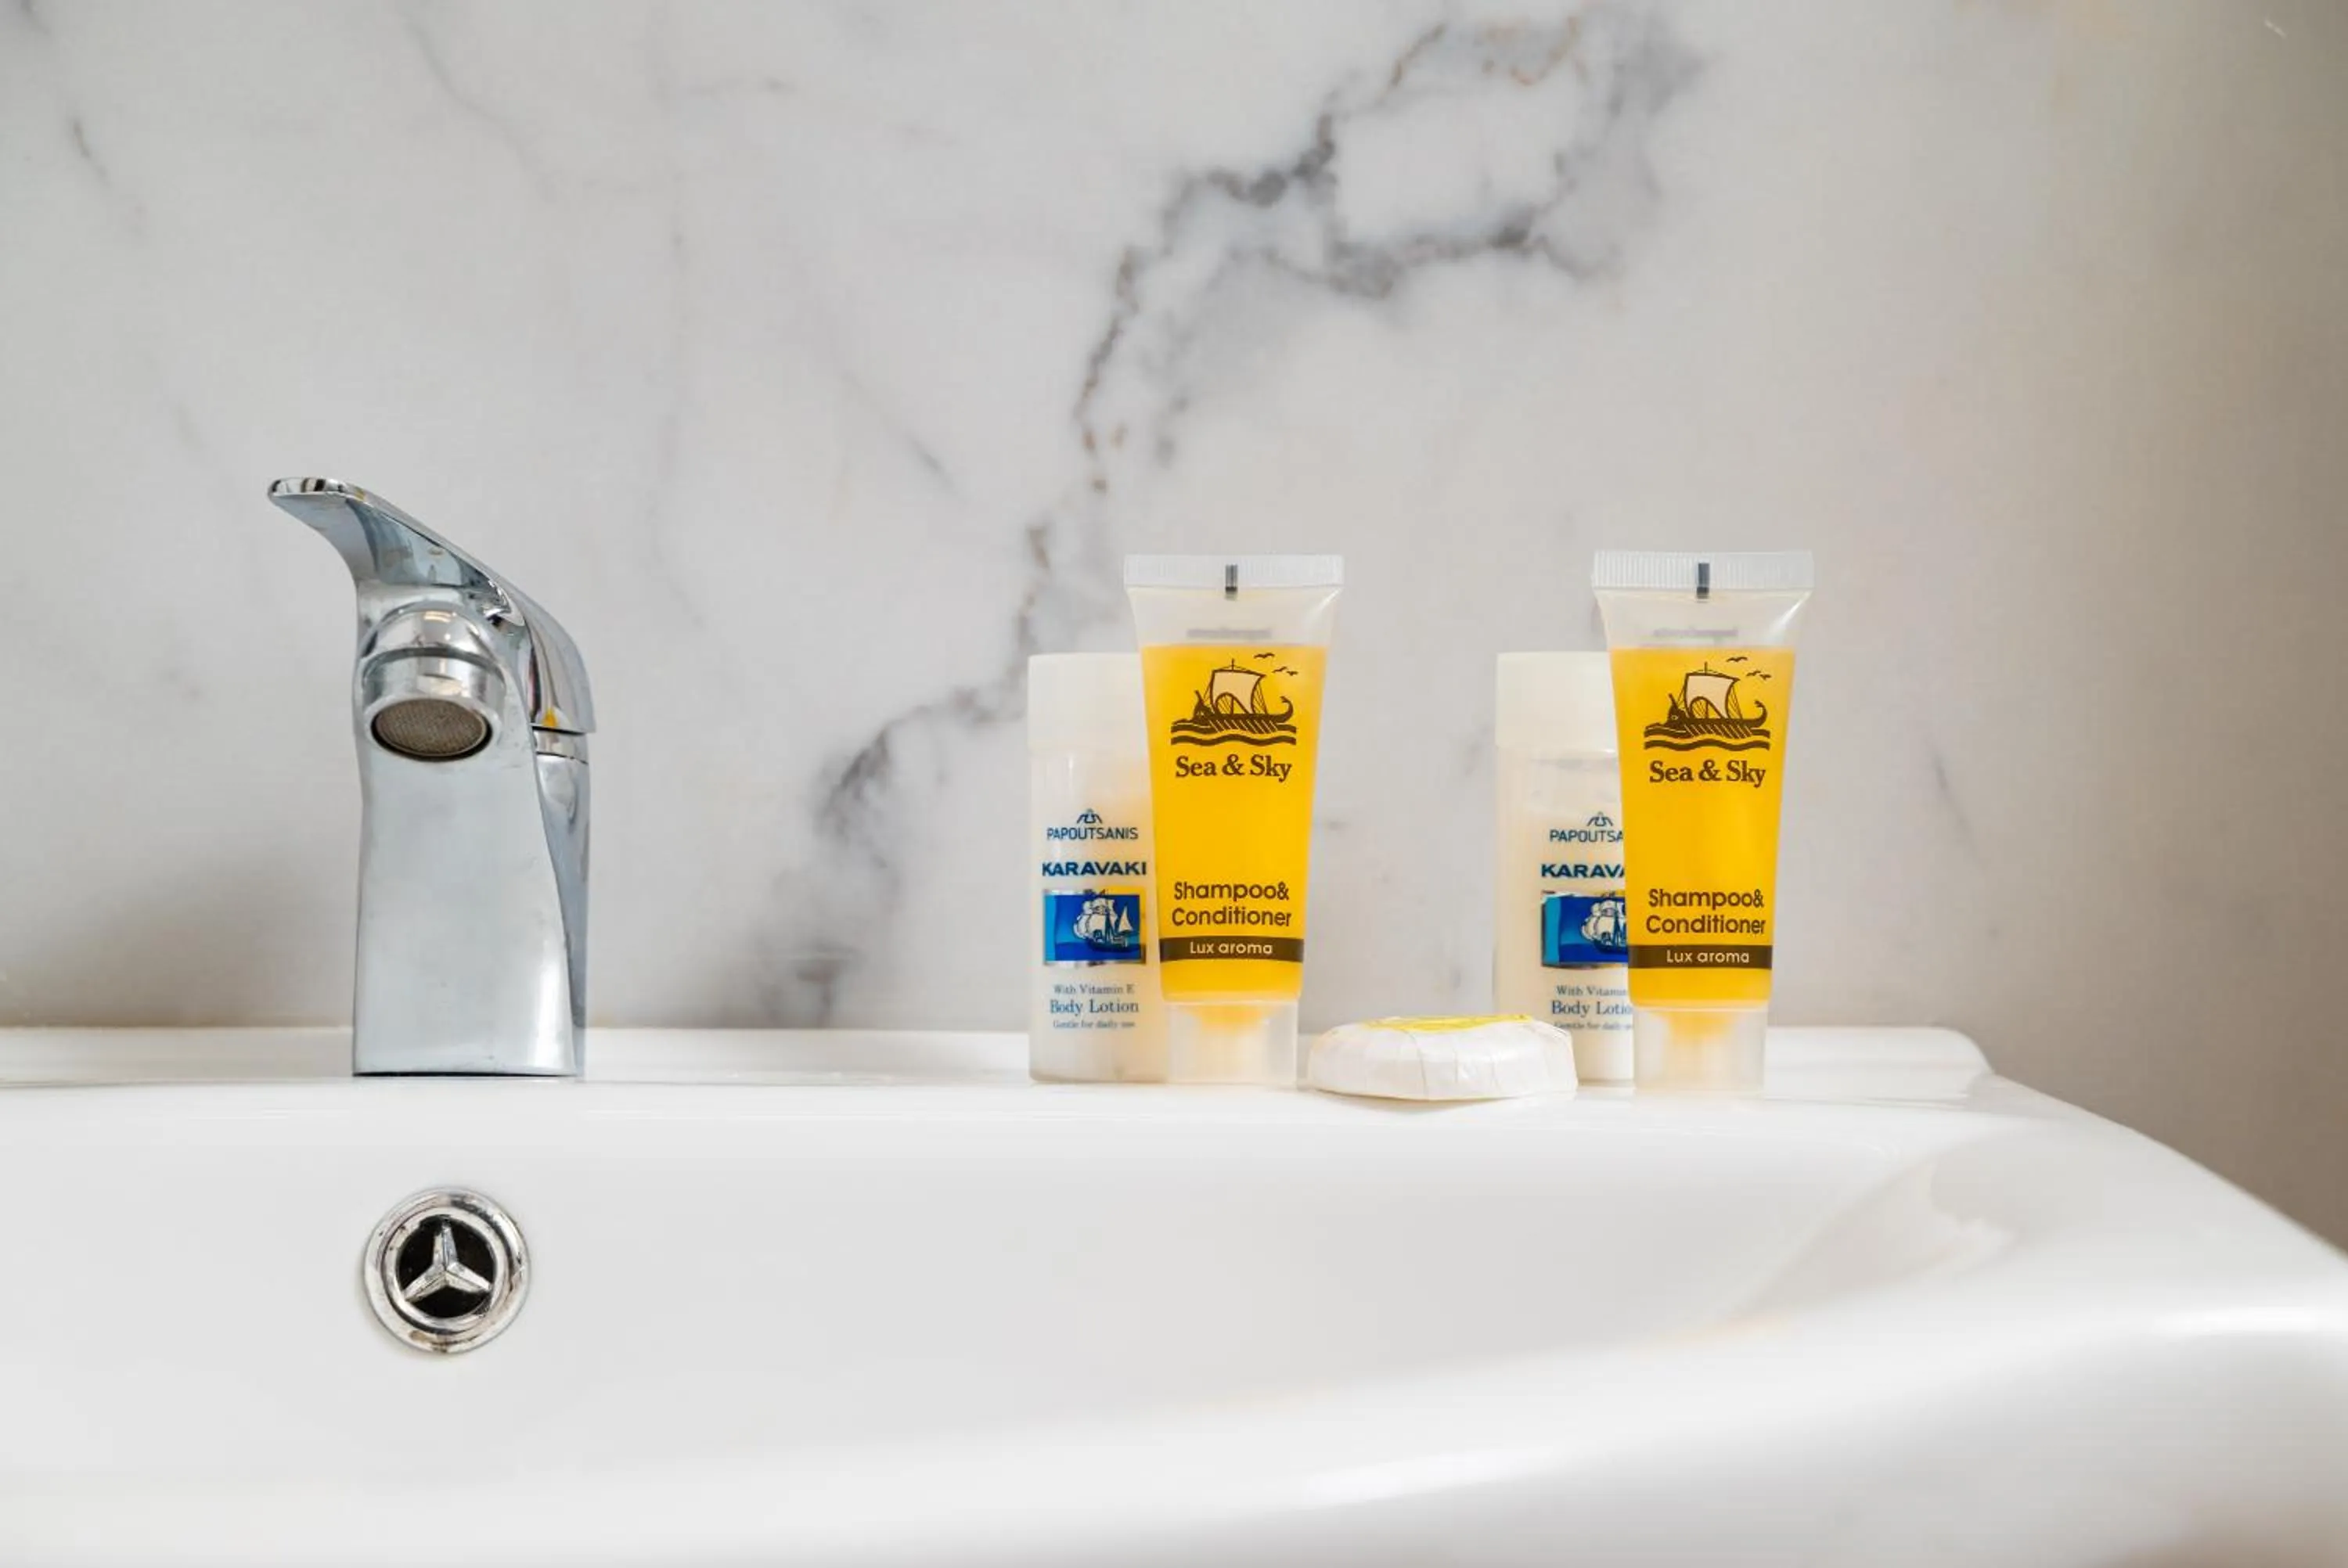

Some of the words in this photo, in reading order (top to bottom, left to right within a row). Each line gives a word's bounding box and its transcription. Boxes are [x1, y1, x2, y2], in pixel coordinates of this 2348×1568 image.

[1176, 755, 1217, 778] Sea
[1222, 753, 1245, 777] &
[1250, 753, 1292, 782] Sky
[1649, 760, 1694, 783] Sea
[1698, 759, 1722, 782] &
[1726, 759, 1766, 788] Sky
[1046, 827, 1139, 840] PAPOUTSANIS
[1042, 861, 1147, 876] KARAVAKI
[1173, 880, 1290, 902] Shampoo&
[1648, 888, 1764, 911] Shampoo&
[1172, 907, 1291, 927] Conditioner
[1646, 915, 1766, 935] Conditioner
[1190, 940, 1214, 955] Lux
[1219, 942, 1273, 955] aroma
[1666, 949, 1693, 964] Lux
[1697, 951, 1750, 964] aroma
[1053, 984, 1076, 994] With
[1079, 984, 1124, 994] Vitamin
[1556, 985, 1584, 996] With
[1050, 998, 1083, 1016] Body
[1089, 998, 1140, 1014] Lotion
[1552, 999, 1590, 1018] Body
